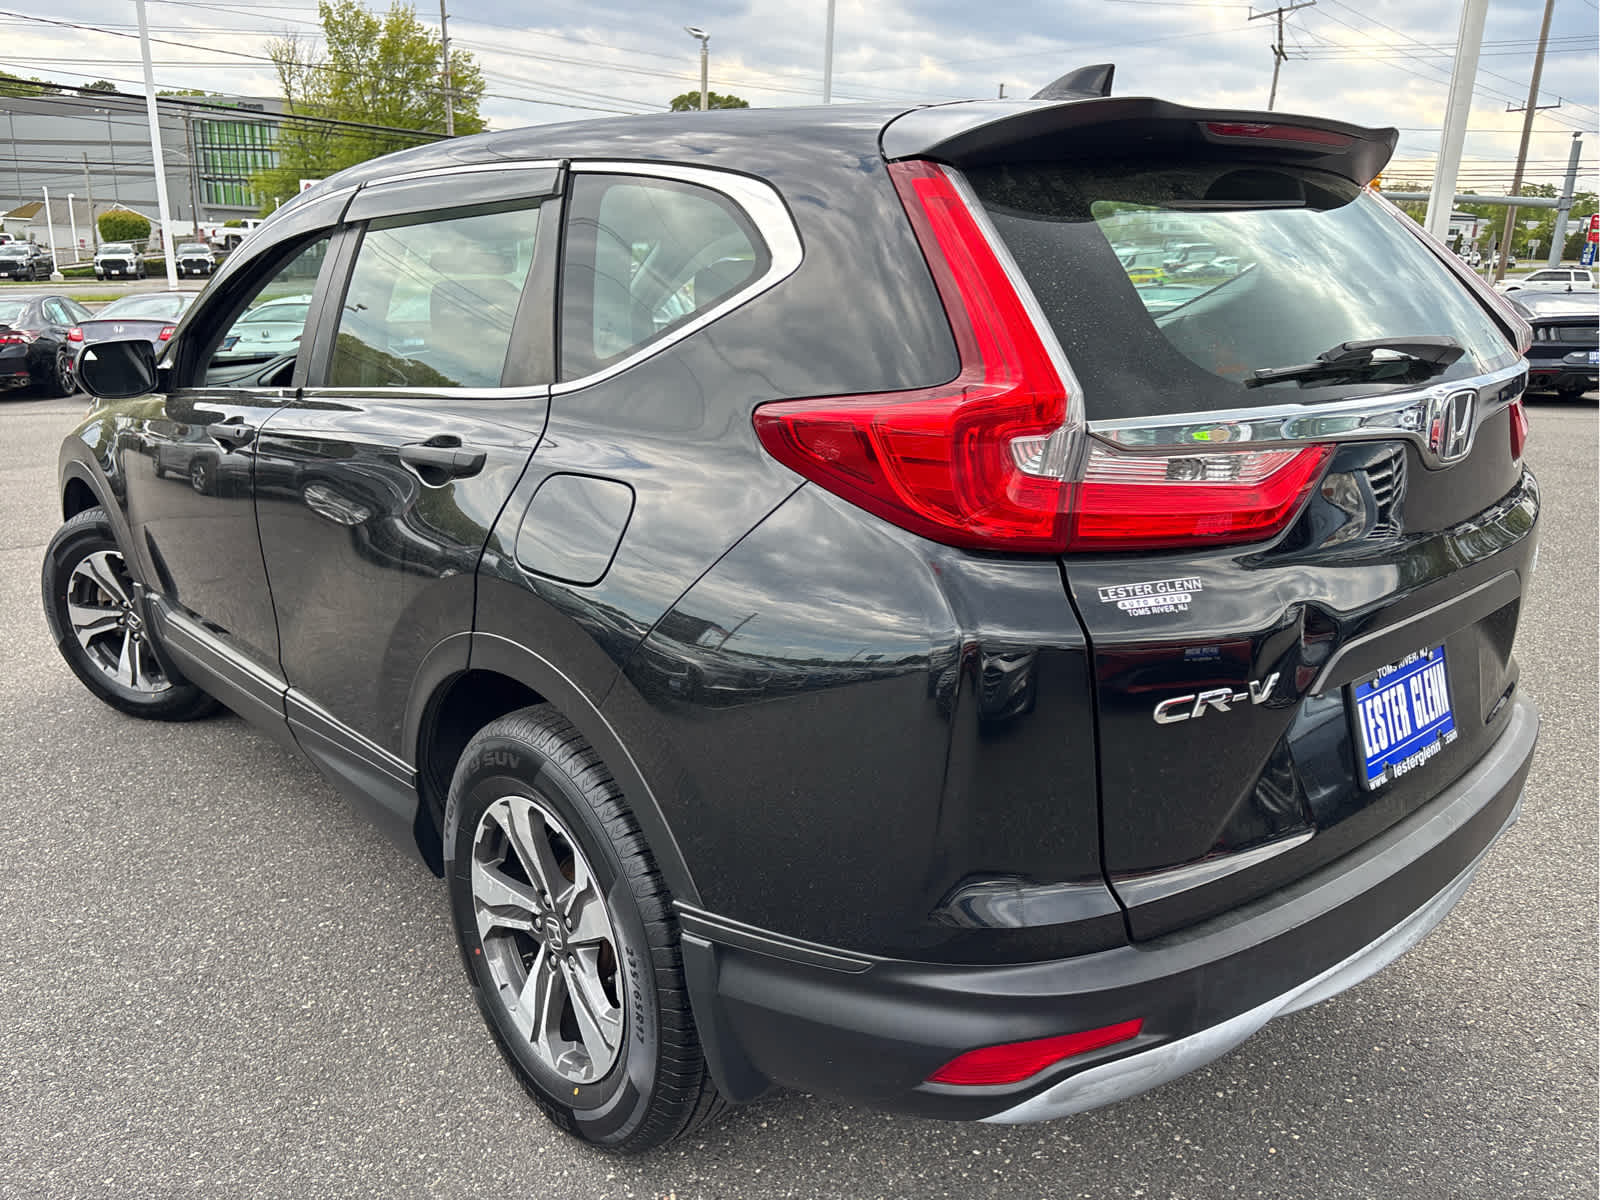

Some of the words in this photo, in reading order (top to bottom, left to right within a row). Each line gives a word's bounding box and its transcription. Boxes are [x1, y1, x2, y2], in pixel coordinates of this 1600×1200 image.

[1098, 584, 1153, 600] LESTER
[1156, 579, 1202, 592] GLENN
[1119, 599, 1149, 609] AUTO
[1127, 607, 1151, 616] TOMS
[1178, 603, 1188, 611] NJ
[1377, 664, 1398, 678] TOMS
[1153, 671, 1280, 725] CR-V
[1358, 683, 1412, 758] LESTER
[1409, 661, 1450, 730] GLENN
[482, 751, 520, 769] SUV
[1392, 741, 1441, 778] lesterglenn
